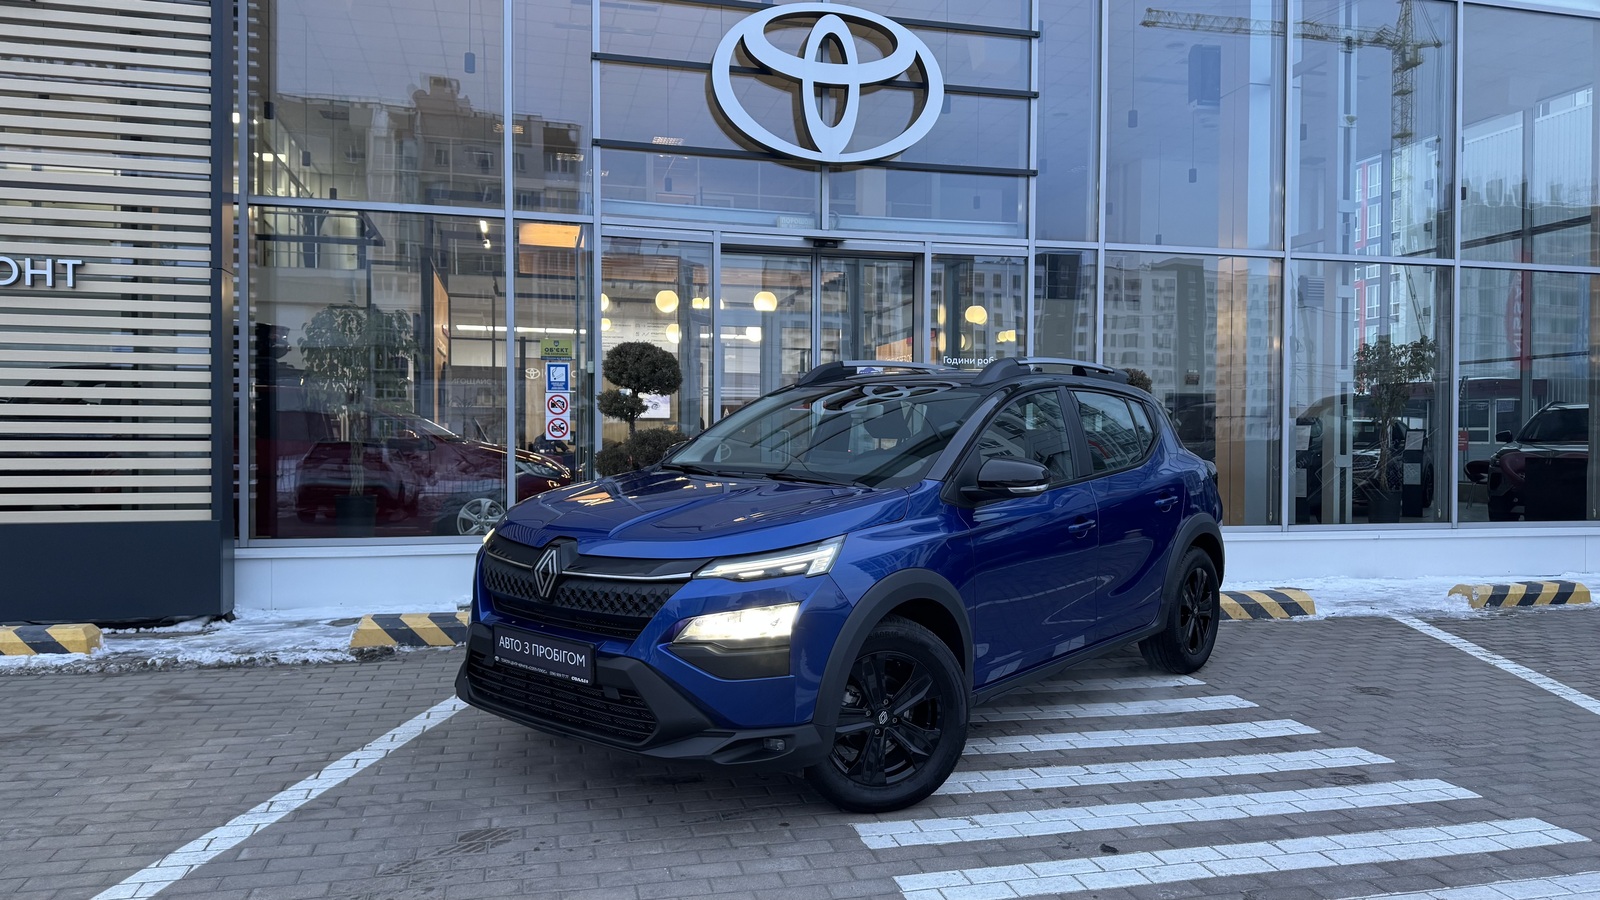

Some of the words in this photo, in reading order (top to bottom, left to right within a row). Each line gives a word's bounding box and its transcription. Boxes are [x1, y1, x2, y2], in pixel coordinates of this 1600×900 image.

[943, 355, 975, 366] Години
[977, 357, 998, 366] роб
[499, 635, 522, 652] АВТО
[532, 644, 586, 667] ПРОБІГОМ
